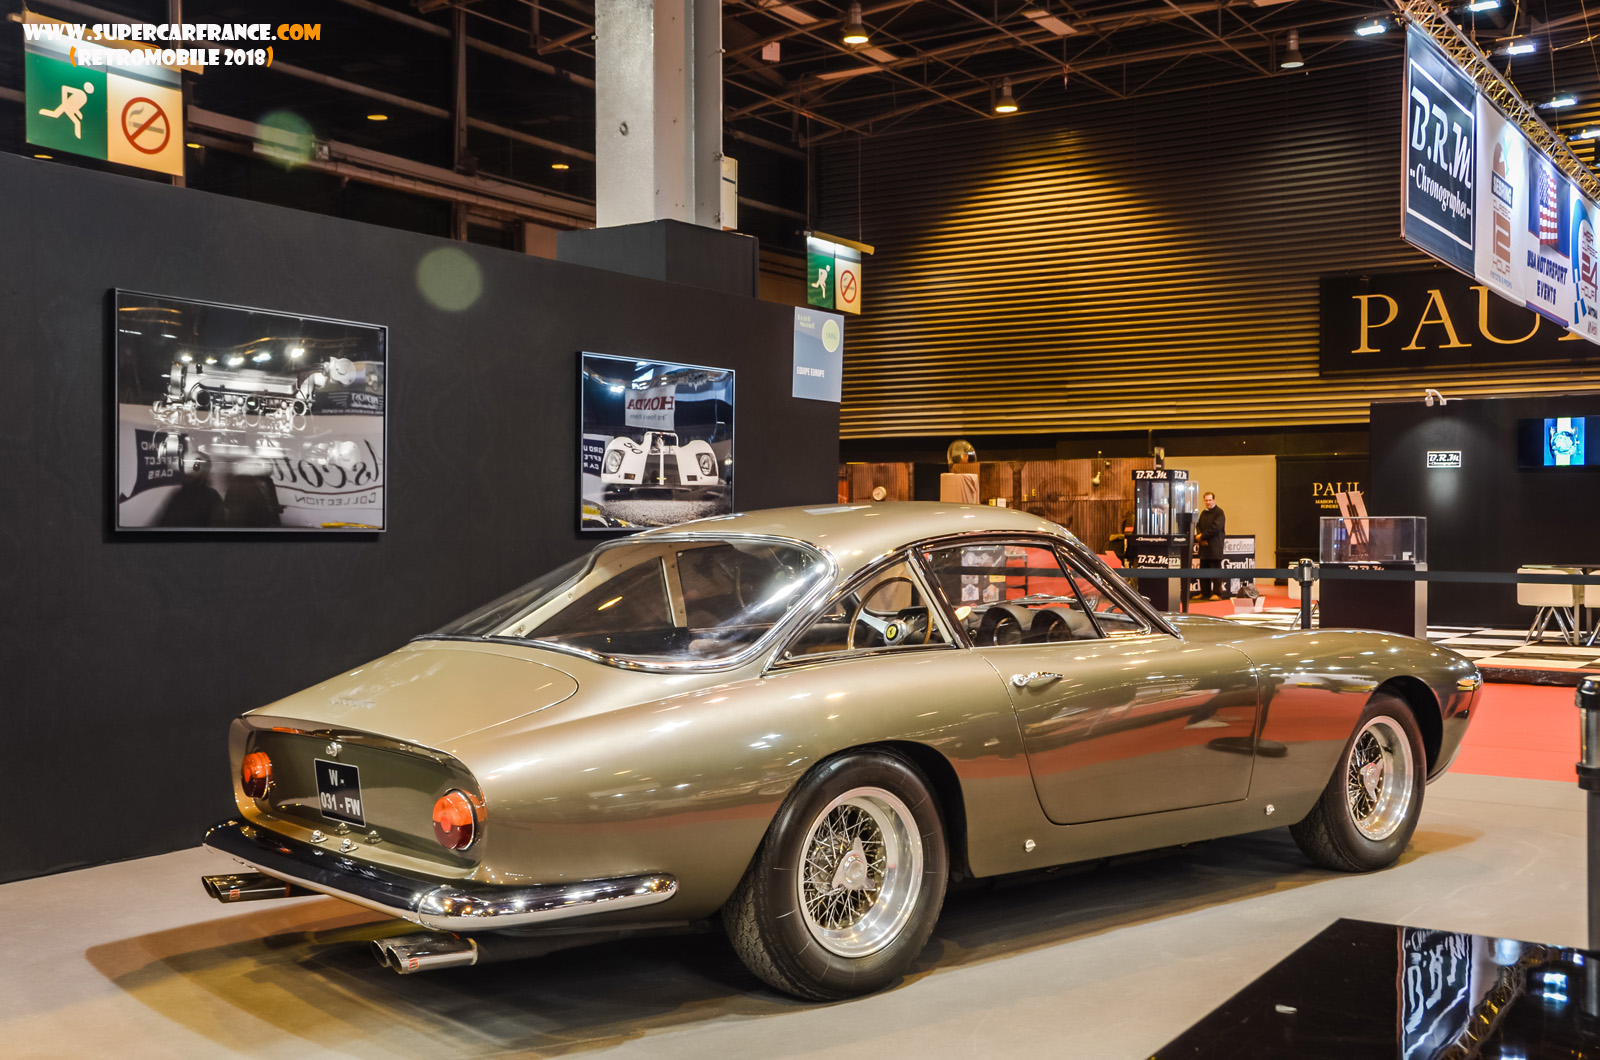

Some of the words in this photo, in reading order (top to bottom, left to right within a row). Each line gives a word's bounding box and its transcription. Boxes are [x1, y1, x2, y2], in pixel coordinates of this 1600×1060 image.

[1411, 86, 1472, 190] B.R.M
[1493, 210, 1511, 264] 12
[1351, 286, 1585, 354] PAU
[1537, 279, 1557, 306] EVENTS
